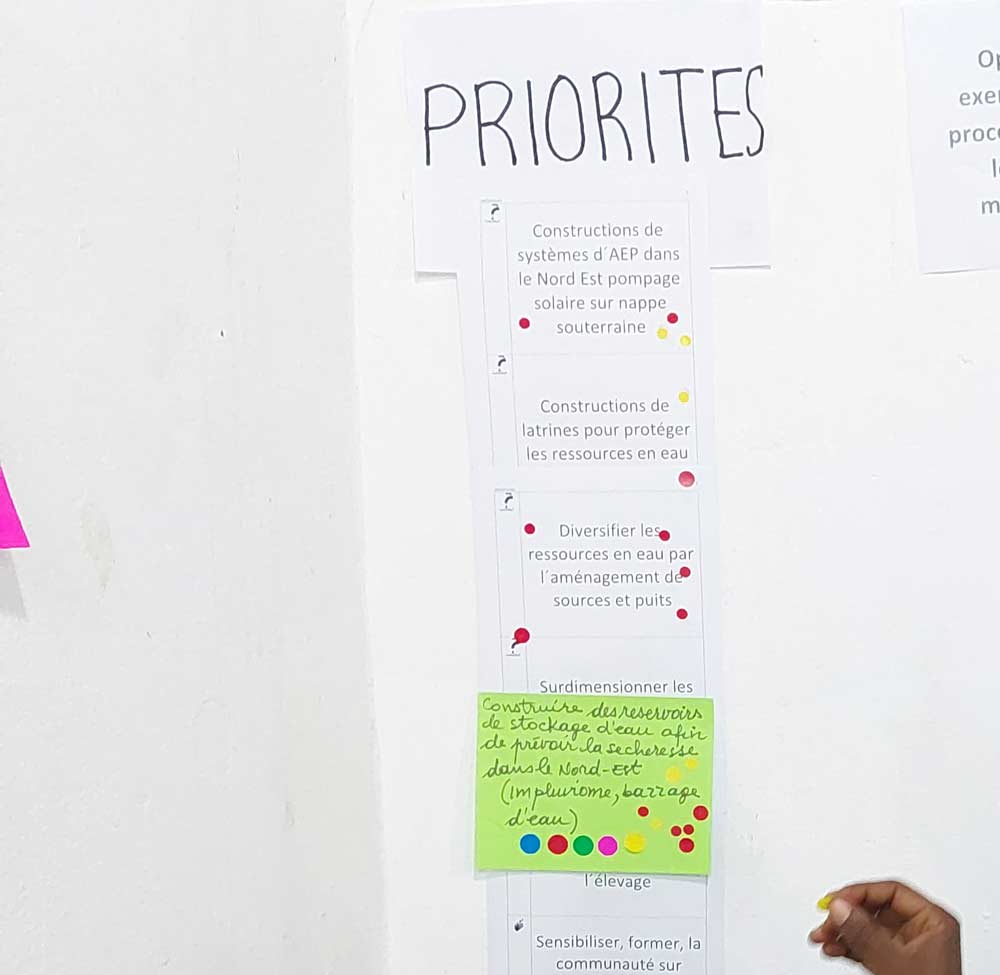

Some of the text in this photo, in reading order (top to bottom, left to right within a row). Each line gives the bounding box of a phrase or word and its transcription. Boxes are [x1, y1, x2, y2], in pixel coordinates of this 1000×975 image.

[424, 65, 764, 166] PRIORITES
[533, 222, 662, 237] Constructions de
[518, 248, 588, 264] systèmes
[644, 247, 679, 260] dans
[519, 272, 679, 288] le Nord Est pompage
[535, 296, 666, 312] solaire sur nappe
[557, 320, 645, 334] souterraine
[541, 398, 669, 413] Constructions de
[523, 422, 690, 440] latrines pour protéger
[527, 447, 687, 460] les ressources en eau
[560, 523, 660, 538] Diversifier les
[529, 550, 694, 563] ressources en eau par
[554, 595, 671, 609] sources et puits
[540, 680, 692, 693] Surdimensionner les
[483, 697, 583, 714] Construire
[587, 702, 617, 718] des
[482, 714, 503, 729] de
[510, 716, 591, 740] stockage
[597, 721, 653, 736] d'eau
[480, 734, 506, 750] de
[579, 737, 603, 754] la
[482, 758, 533, 778] dans
[505, 808, 579, 835] d'eau)
[537, 935, 700, 952] Sensibiliser, former, la
[557, 959, 681, 971] communauté sur
